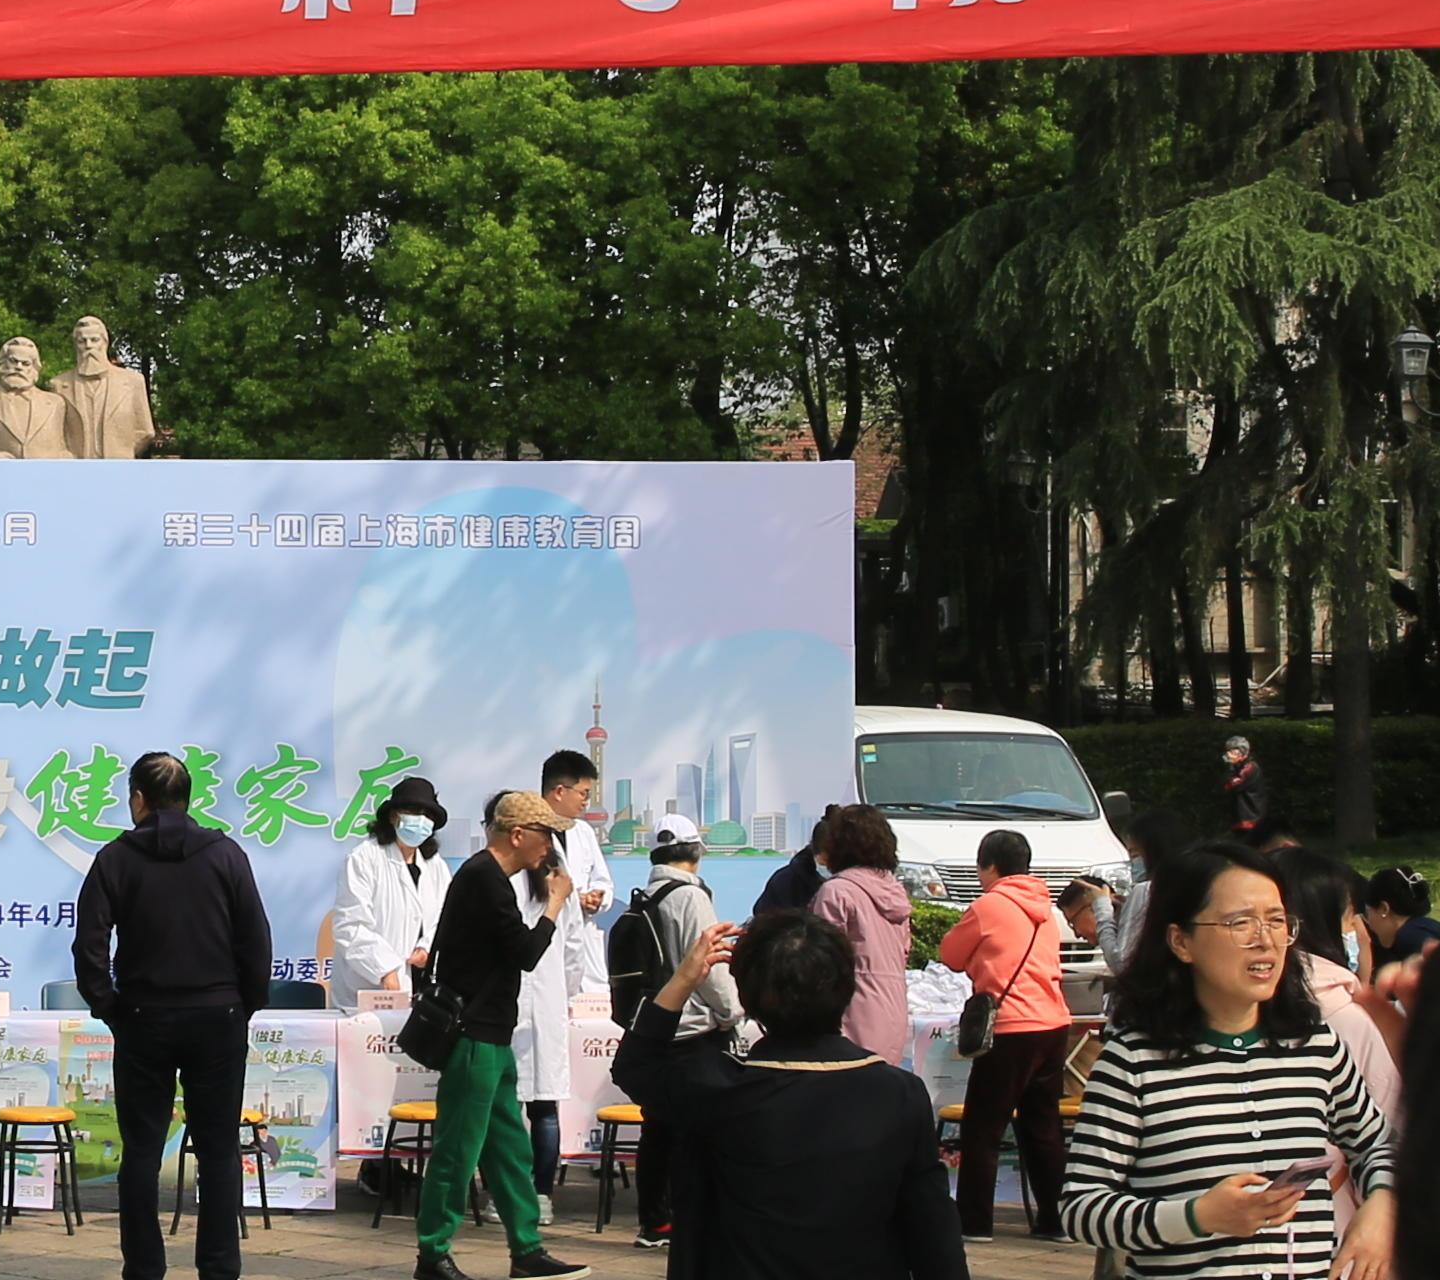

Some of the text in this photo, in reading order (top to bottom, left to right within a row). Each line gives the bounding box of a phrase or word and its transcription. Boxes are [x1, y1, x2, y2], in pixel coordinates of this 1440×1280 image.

[163, 512, 642, 550] 第三十四届上海市健康教育周
